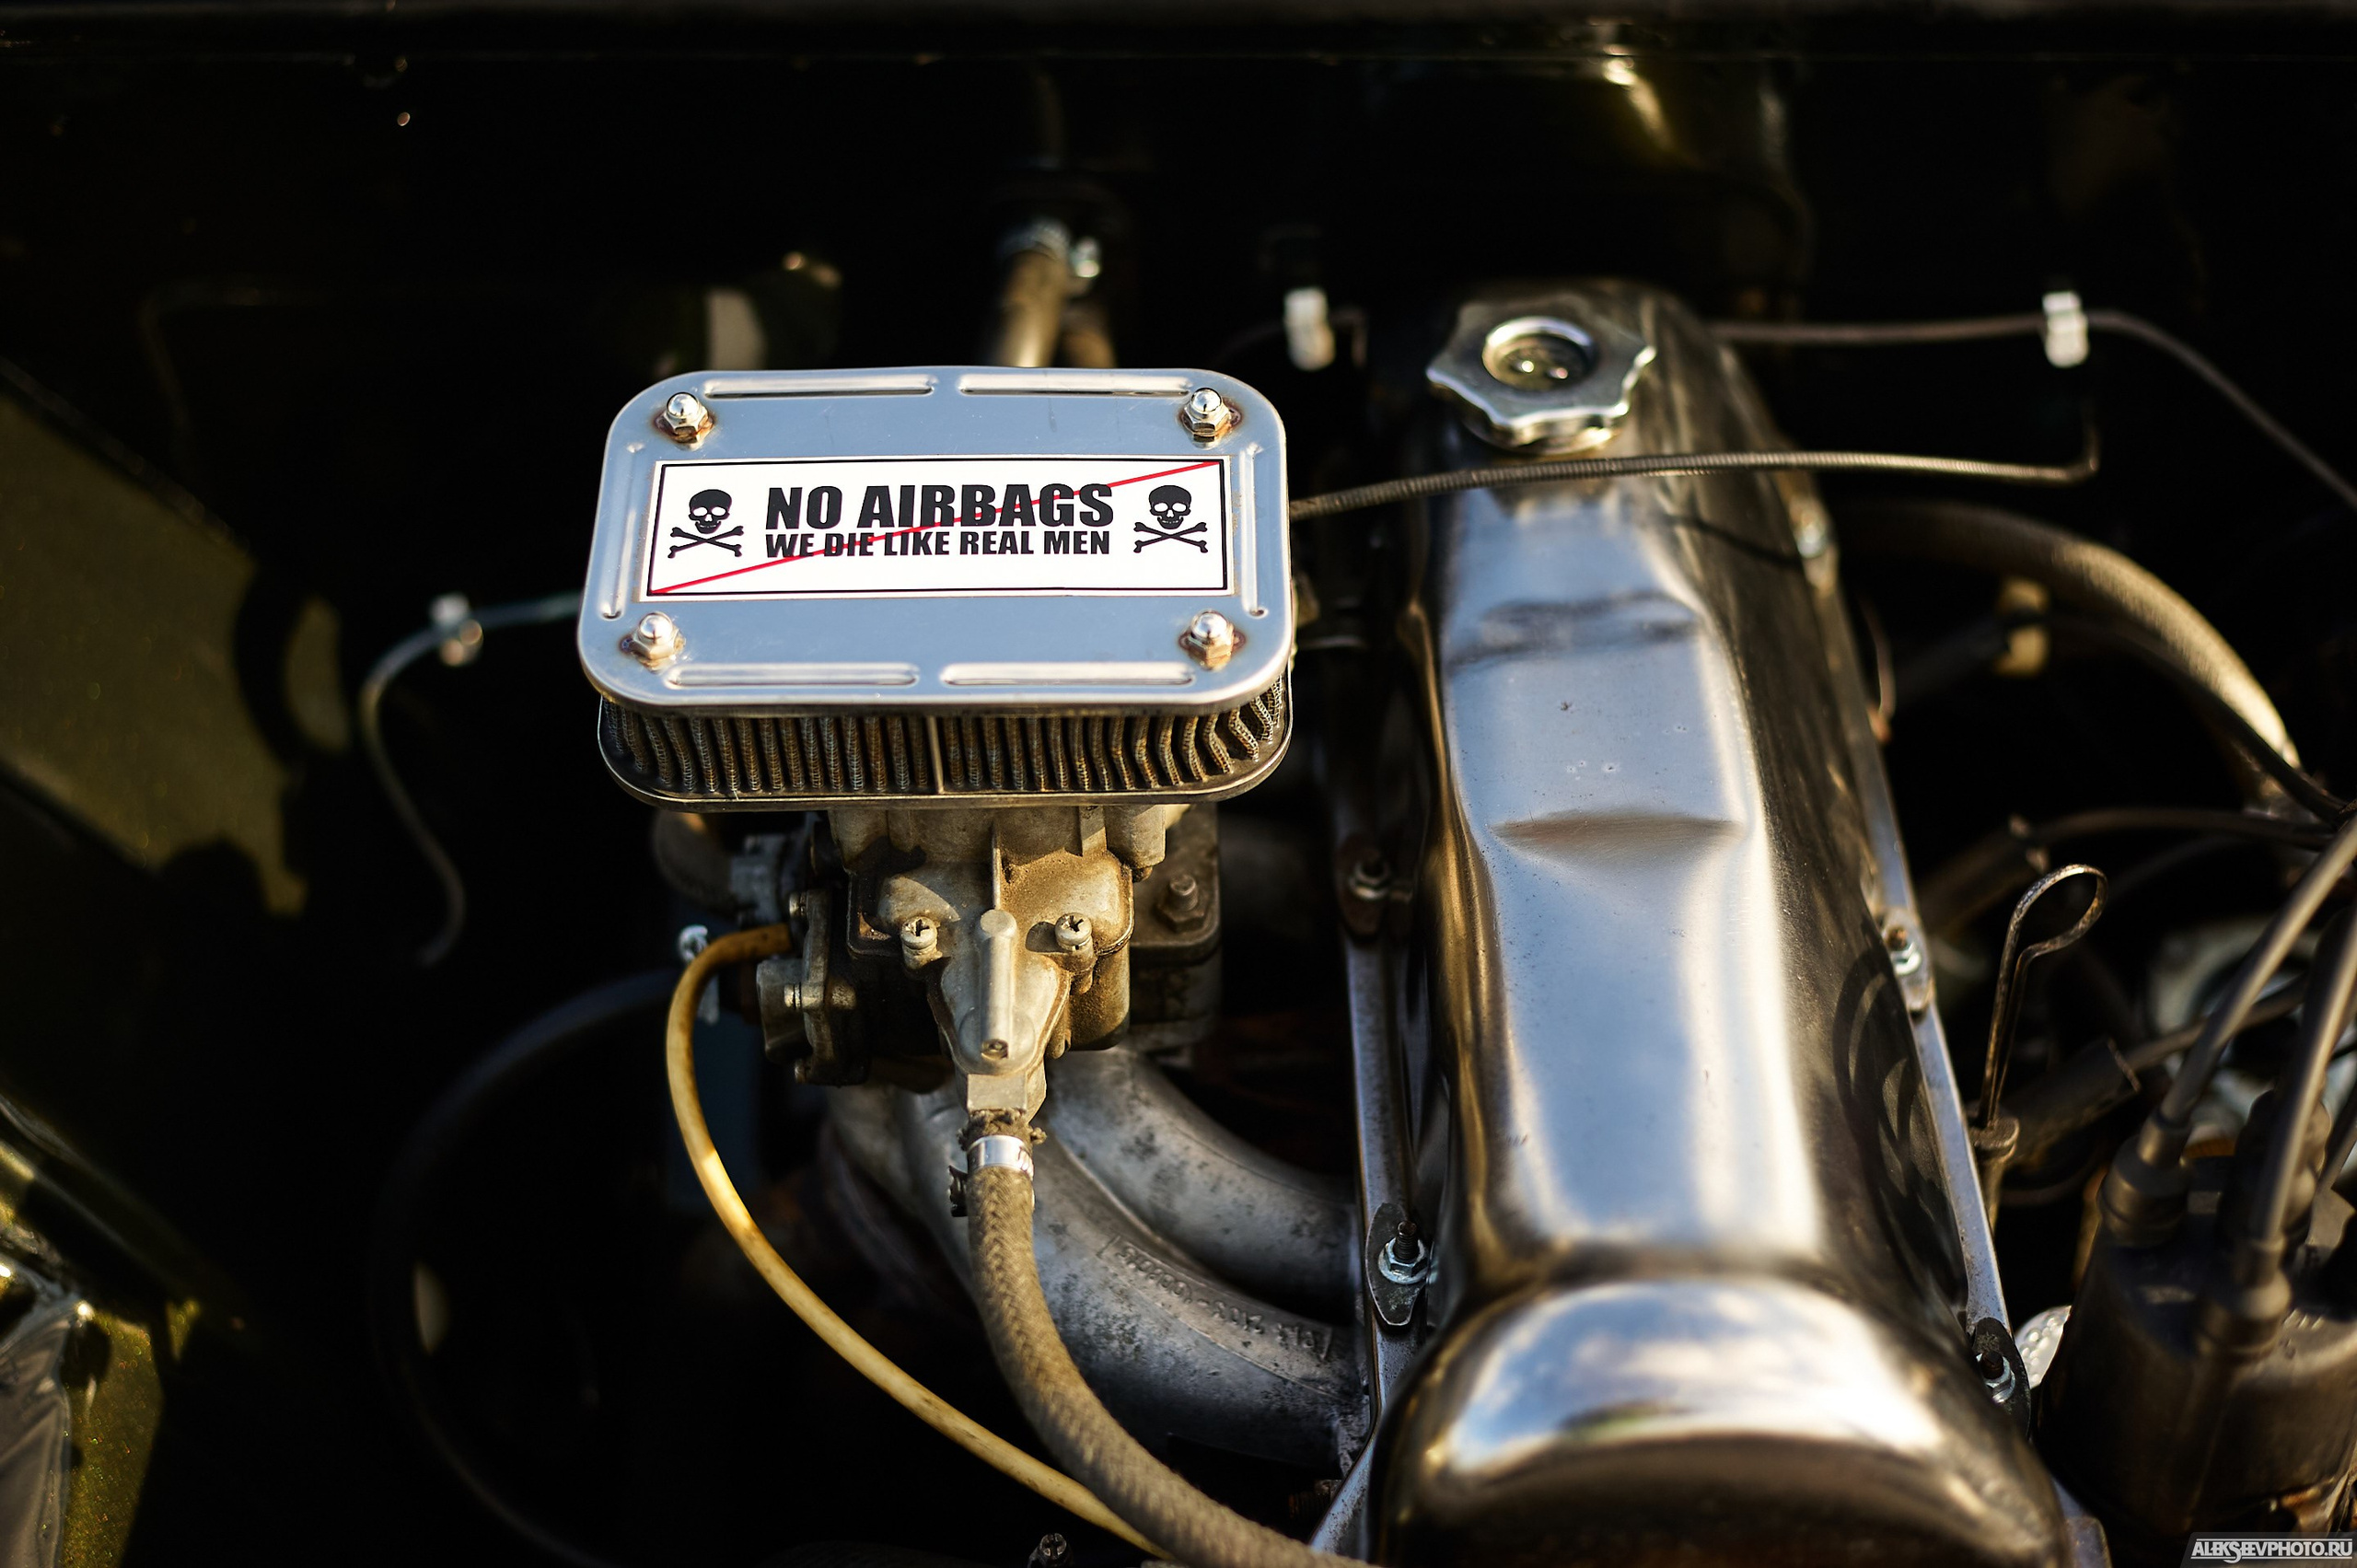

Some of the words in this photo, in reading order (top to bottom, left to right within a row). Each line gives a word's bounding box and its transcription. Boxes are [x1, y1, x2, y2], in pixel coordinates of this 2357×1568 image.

[766, 485, 842, 529] NO
[857, 483, 1114, 528] AIRBAGS
[766, 533, 815, 557] WE
[824, 532, 874, 556] DIE
[884, 531, 950, 556] LIKE
[960, 530, 1034, 555] REAL
[1044, 530, 1109, 555] MEN
